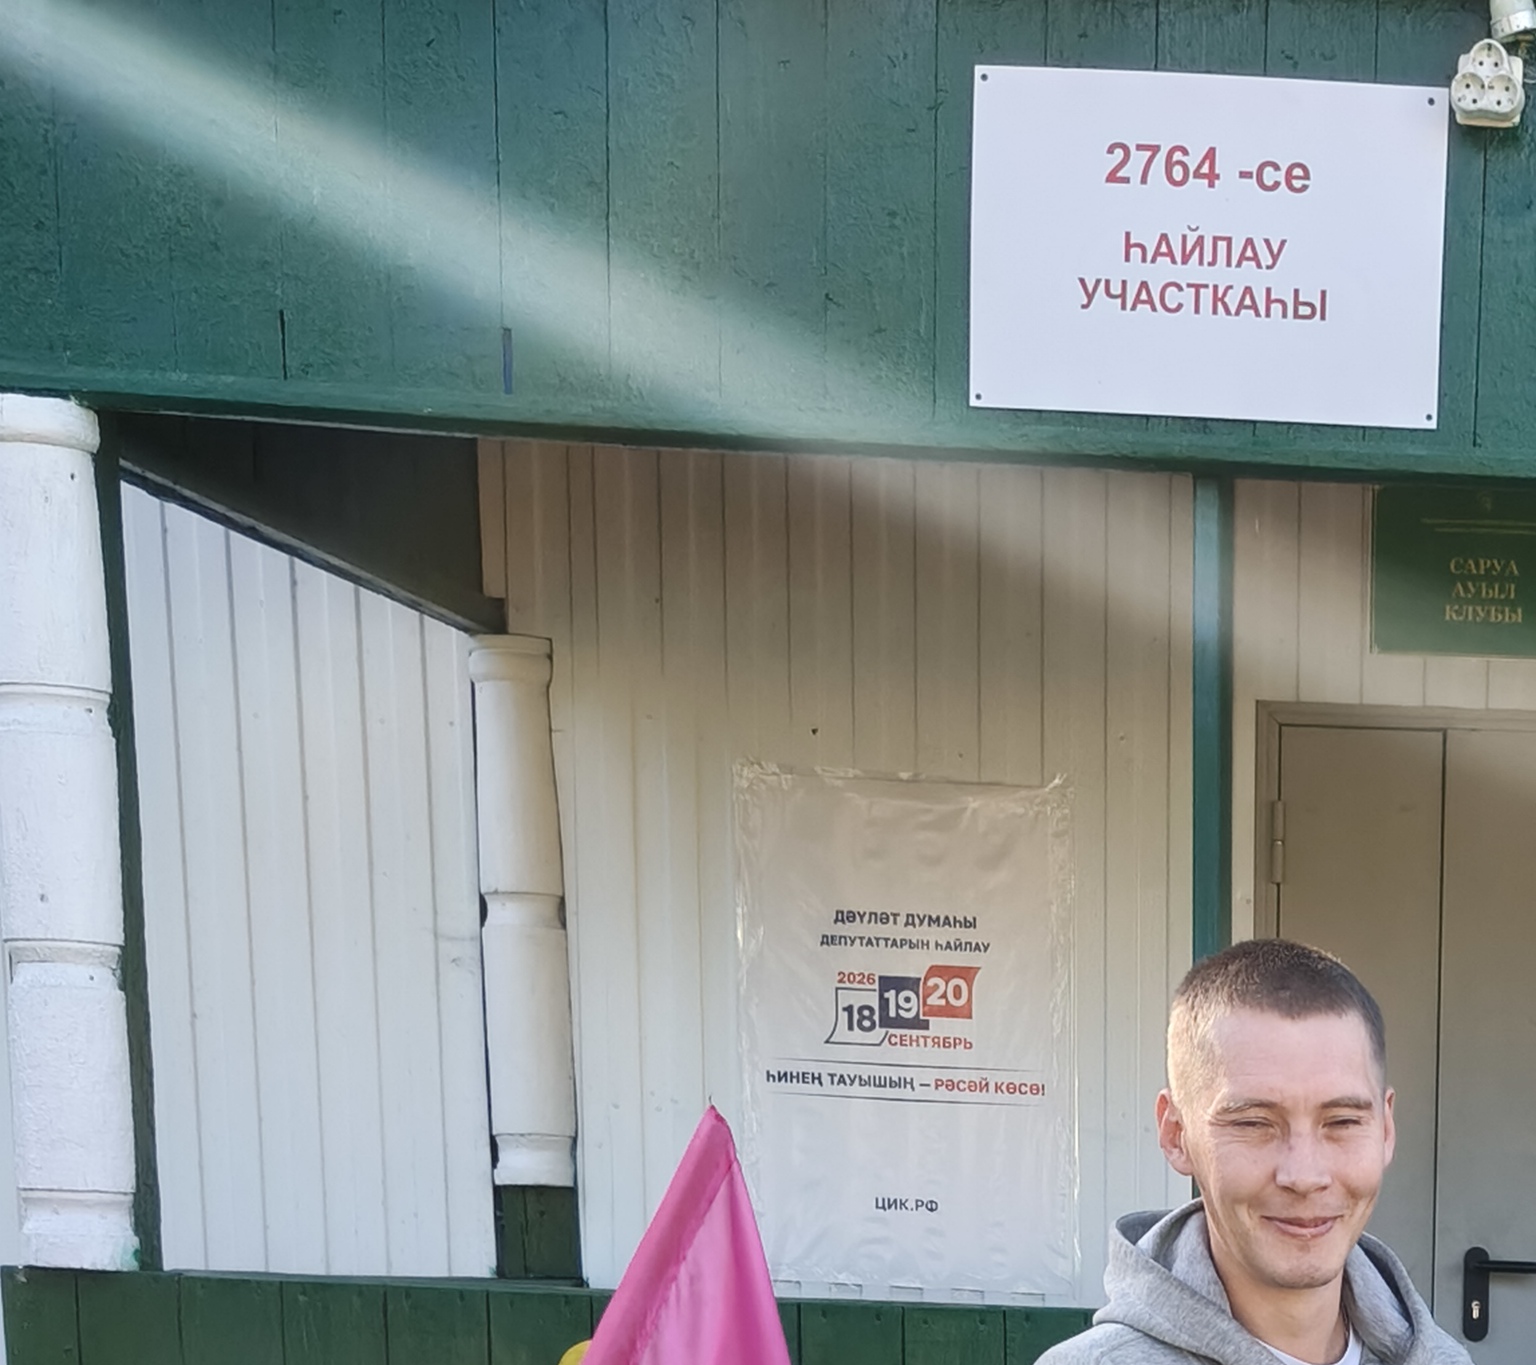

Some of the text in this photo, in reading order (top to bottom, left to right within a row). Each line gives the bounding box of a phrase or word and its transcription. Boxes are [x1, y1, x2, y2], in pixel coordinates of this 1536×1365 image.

[1104, 142, 1311, 194] 2764 -се
[1124, 225, 1287, 270] ҺАЙЛАУ
[1078, 277, 1327, 321] УЧАСТКАҺЫ
[1449, 556, 1520, 577] САРУА
[1451, 581, 1516, 600] АУЫЛ
[1444, 604, 1523, 623] КЛУБЫ
[904, 913, 977, 929] ДУМАҺЫ
[820, 934, 990, 954] ДЕПУТАТТАРЫН ҺАЙЛАУ
[837, 971, 876, 985] 2026
[926, 976, 969, 1007] 20
[883, 989, 918, 1019] 19
[842, 1004, 877, 1033] 18
[887, 1033, 973, 1050] СЕНТЯБРЬ
[765, 1069, 823, 1087] ҺИНЕҢ
[875, 1197, 938, 1213] ЦИК.РФ
